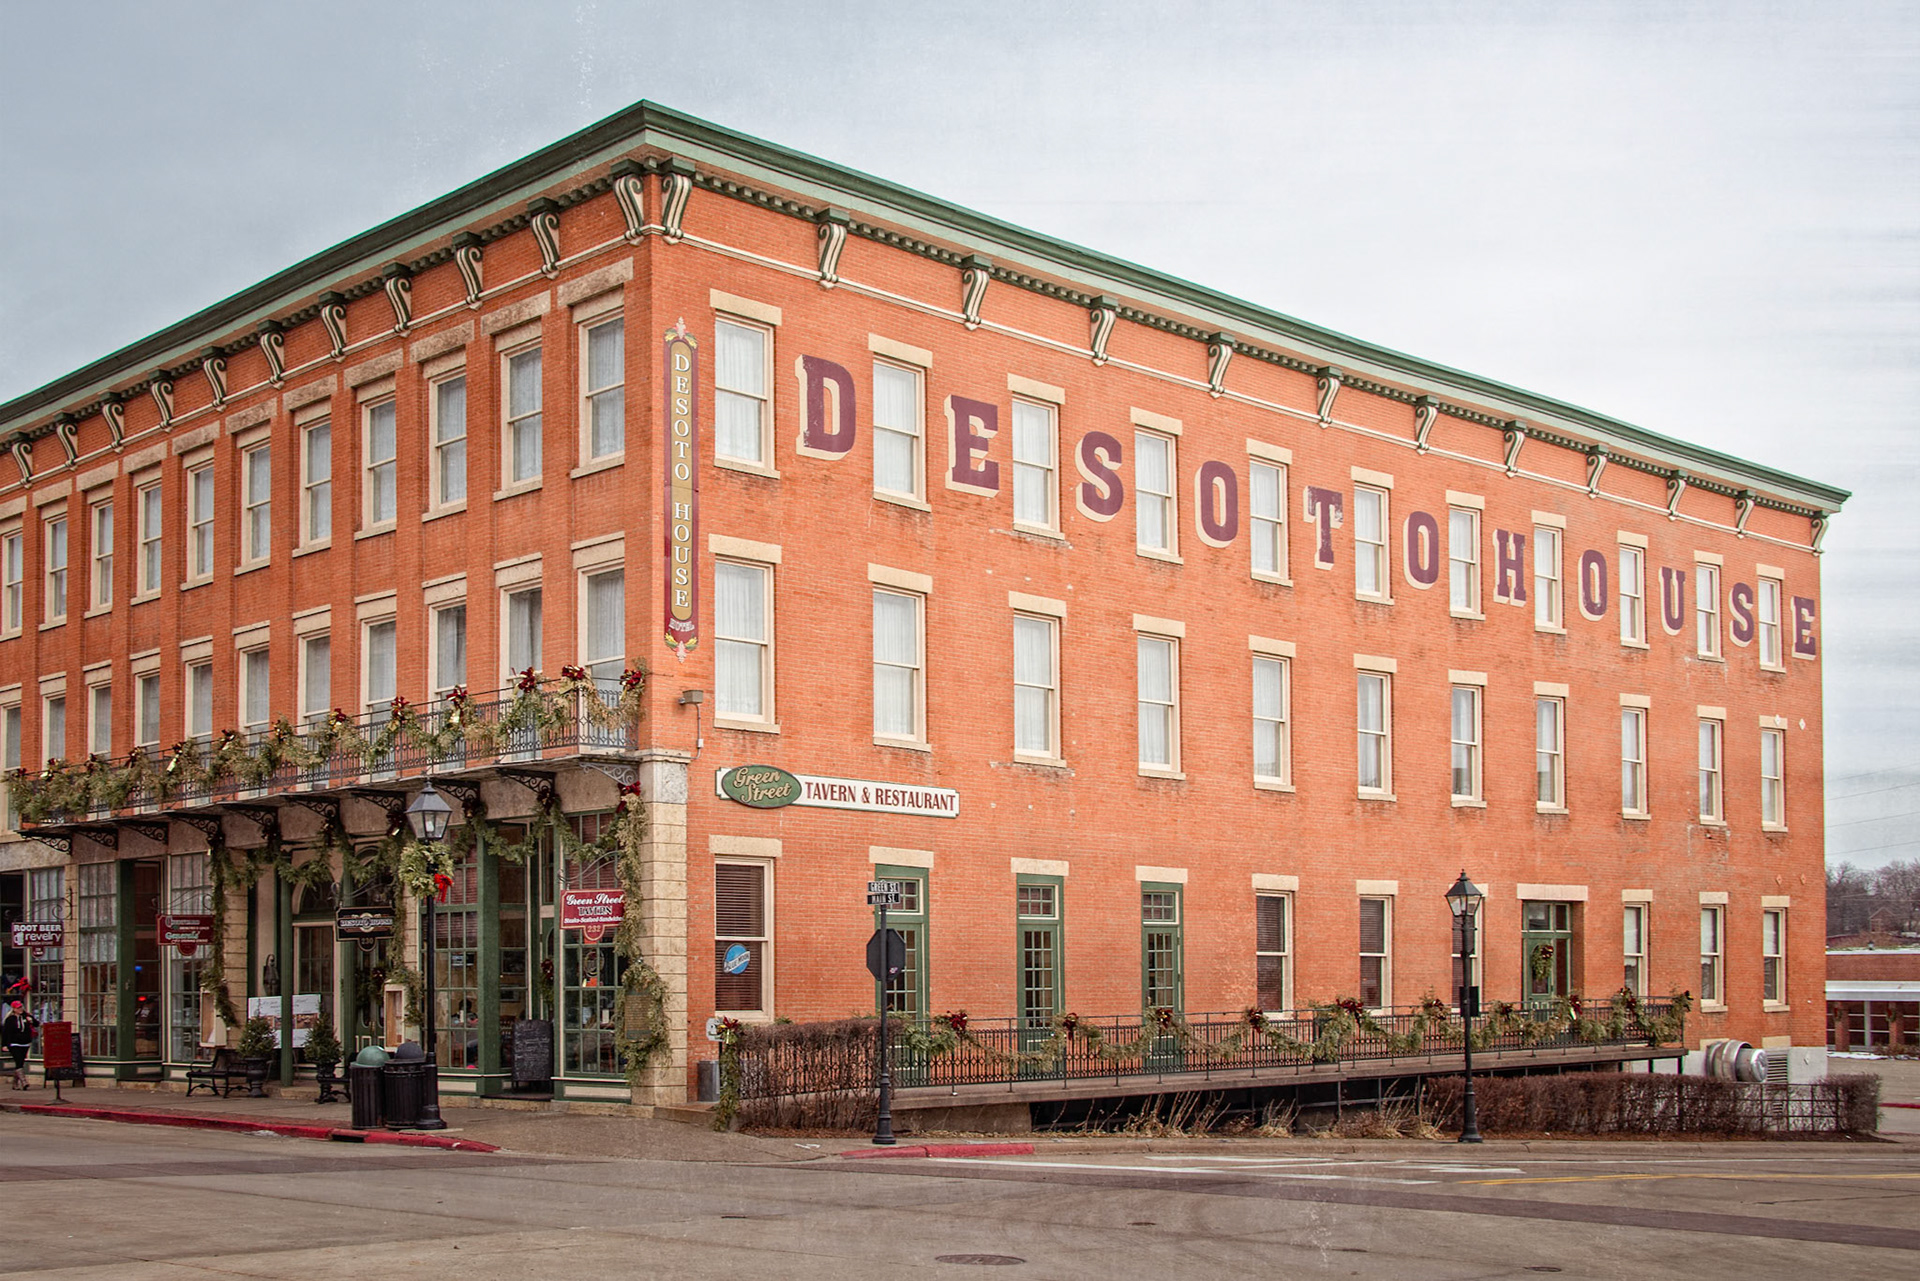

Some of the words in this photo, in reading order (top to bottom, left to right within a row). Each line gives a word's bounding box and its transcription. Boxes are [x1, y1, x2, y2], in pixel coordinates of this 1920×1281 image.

[674, 502, 690, 608] HOUSE
[1493, 528, 1816, 660] HOUSE
[733, 767, 781, 788] Green
[741, 782, 792, 803] Street
[805, 781, 857, 803] TAVERN
[861, 790, 871, 804] &
[875, 790, 956, 812] RESTAURANT
[871, 882, 888, 892] GREEN
[566, 894, 593, 906] Green
[594, 893, 625, 905] Street
[577, 905, 613, 916] TAVERN
[25, 931, 61, 942] revelry
[587, 925, 602, 933] 232
